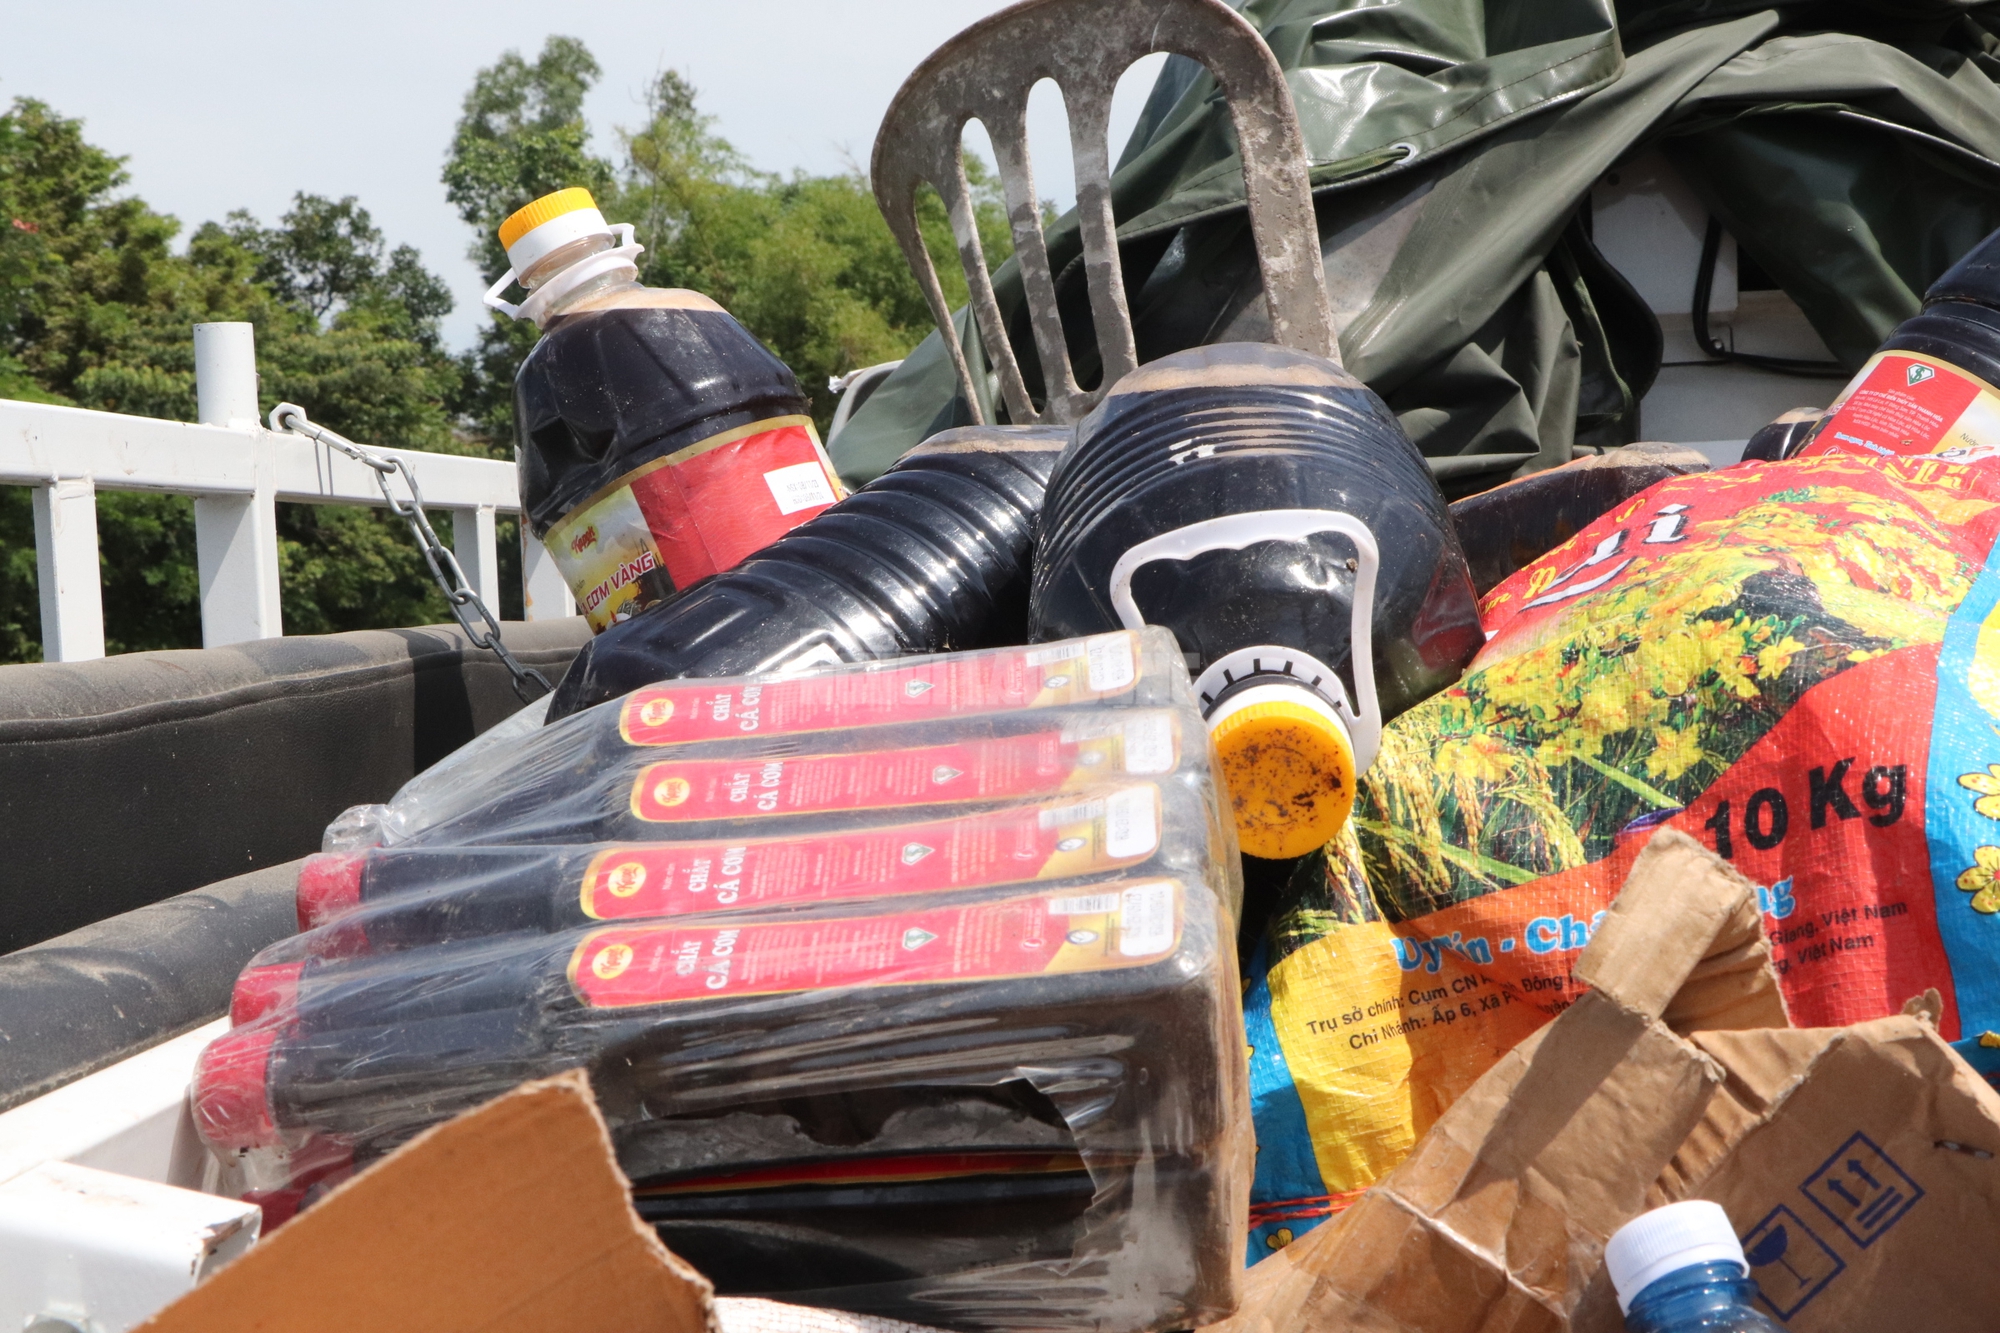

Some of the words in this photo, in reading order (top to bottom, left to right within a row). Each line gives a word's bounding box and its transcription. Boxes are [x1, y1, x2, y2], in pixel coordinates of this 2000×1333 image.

[585, 580, 611, 612] CƠM
[610, 551, 655, 591] VÀNG
[735, 708, 760, 731] CÁ
[753, 790, 779, 811] CÁ
[1704, 786, 1789, 860] 10
[1807, 756, 1908, 831] Kg
[714, 878, 741, 904] CÁ
[1821, 907, 1858, 927] Việt
[1863, 901, 1908, 920] Nam
[1796, 940, 1828, 965] Việt
[1828, 933, 1875, 954] Nam
[701, 959, 731, 990] CÁ
[1306, 1017, 1339, 1035] Trụ
[1341, 1005, 1364, 1025] sở
[1367, 995, 1405, 1017] chính:
[1407, 986, 1449, 1006] Cụm
[1451, 974, 1479, 994] CN
[1348, 1028, 1380, 1050] Chi
[1381, 1015, 1428, 1041] Nhánh:
[1431, 1003, 1457, 1025] Ấp
[1459, 1001, 1478, 1018] 6,
[1478, 993, 1501, 1012] Xã
